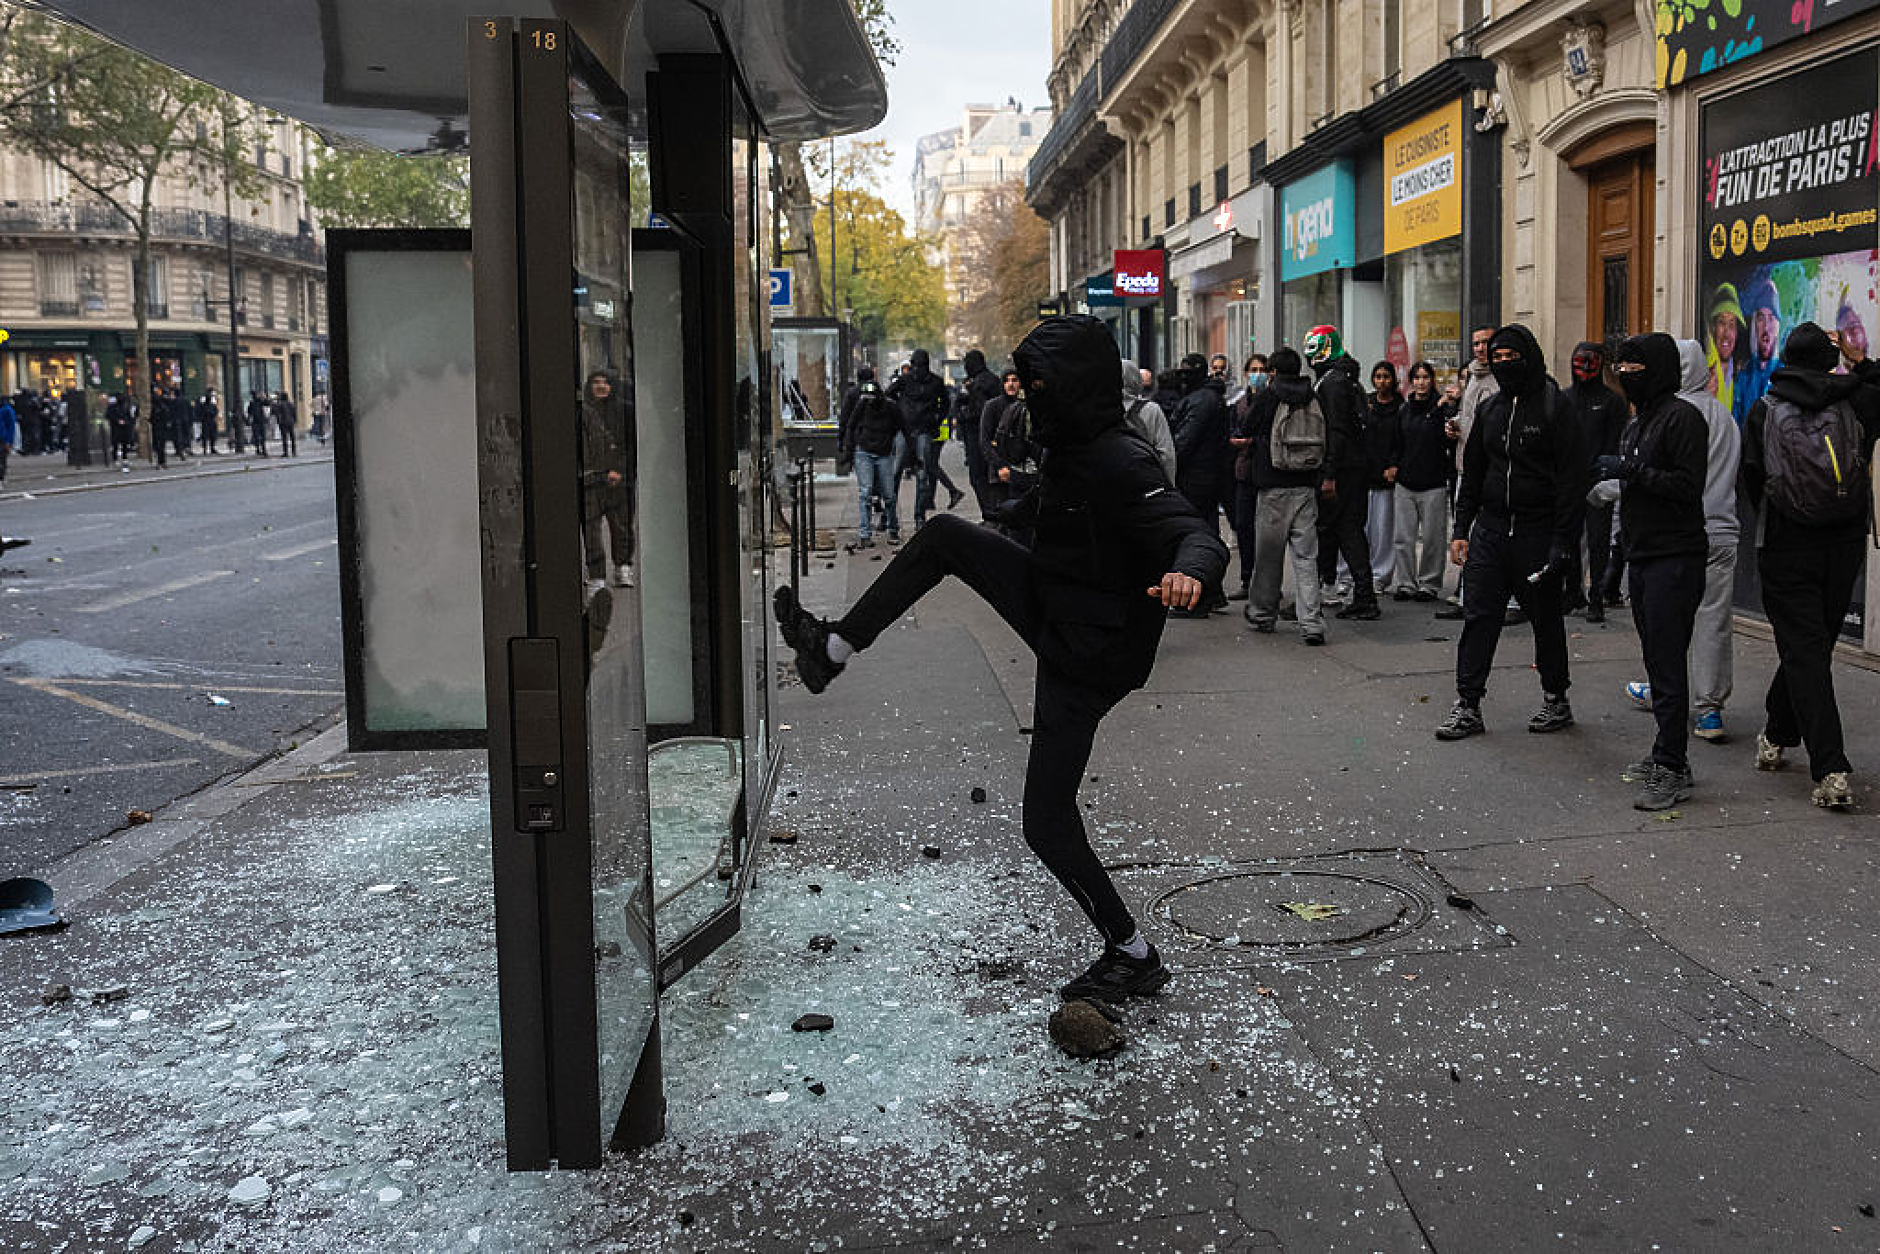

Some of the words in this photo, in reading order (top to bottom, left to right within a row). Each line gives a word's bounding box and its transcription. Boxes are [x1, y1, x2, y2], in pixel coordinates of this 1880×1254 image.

[484, 21, 497, 39] 3
[531, 30, 556, 51] 18
[1719, 130, 1807, 174] L'ATTRACTION
[1807, 124, 1826, 151] LA
[1830, 112, 1870, 145] PLUS
[1714, 169, 1753, 210] FUN
[1754, 161, 1784, 200] DE
[1786, 145, 1851, 193] PARIS
[1284, 197, 1334, 263] hygena
[769, 276, 783, 302] P
[1115, 271, 1160, 293] Epeda
